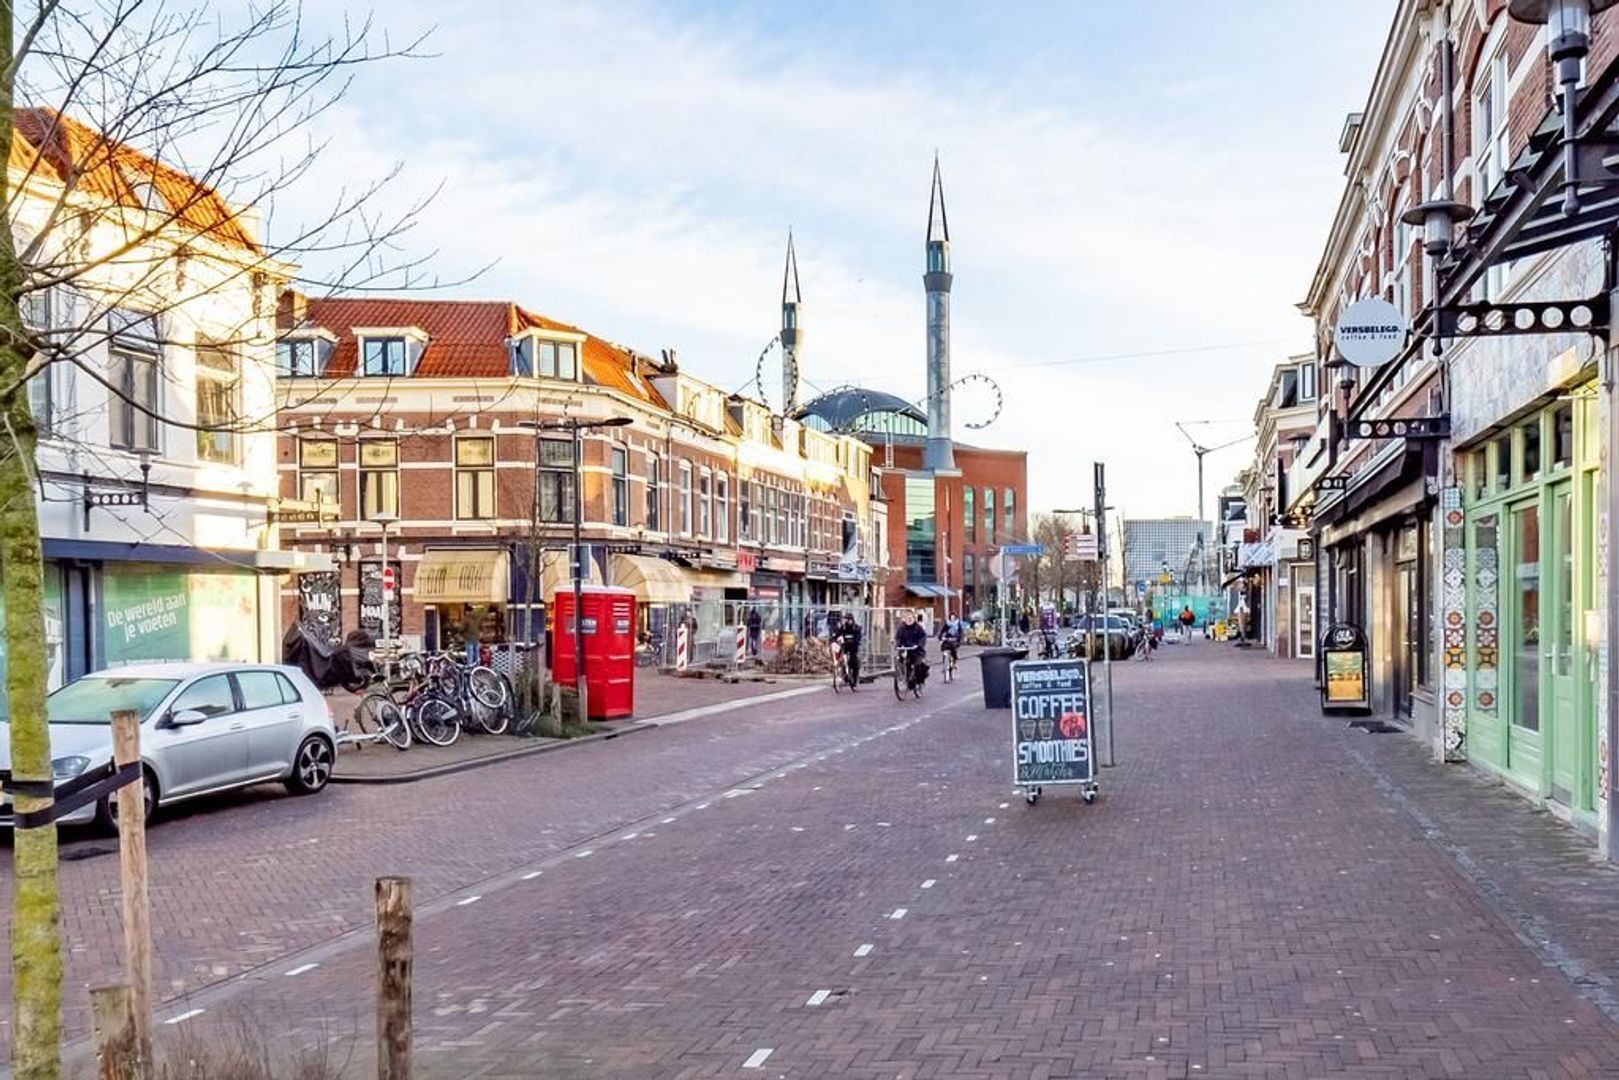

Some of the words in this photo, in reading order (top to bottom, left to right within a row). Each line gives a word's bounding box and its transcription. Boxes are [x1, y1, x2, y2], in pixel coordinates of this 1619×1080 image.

[107, 610, 123, 628] De
[125, 598, 164, 622] wereld
[164, 593, 187, 610] aan
[124, 622, 136, 643] je
[138, 611, 177, 634] voeten
[1017, 693, 1084, 719] COFFEE
[1019, 739, 1088, 765] SMOOTHIES
